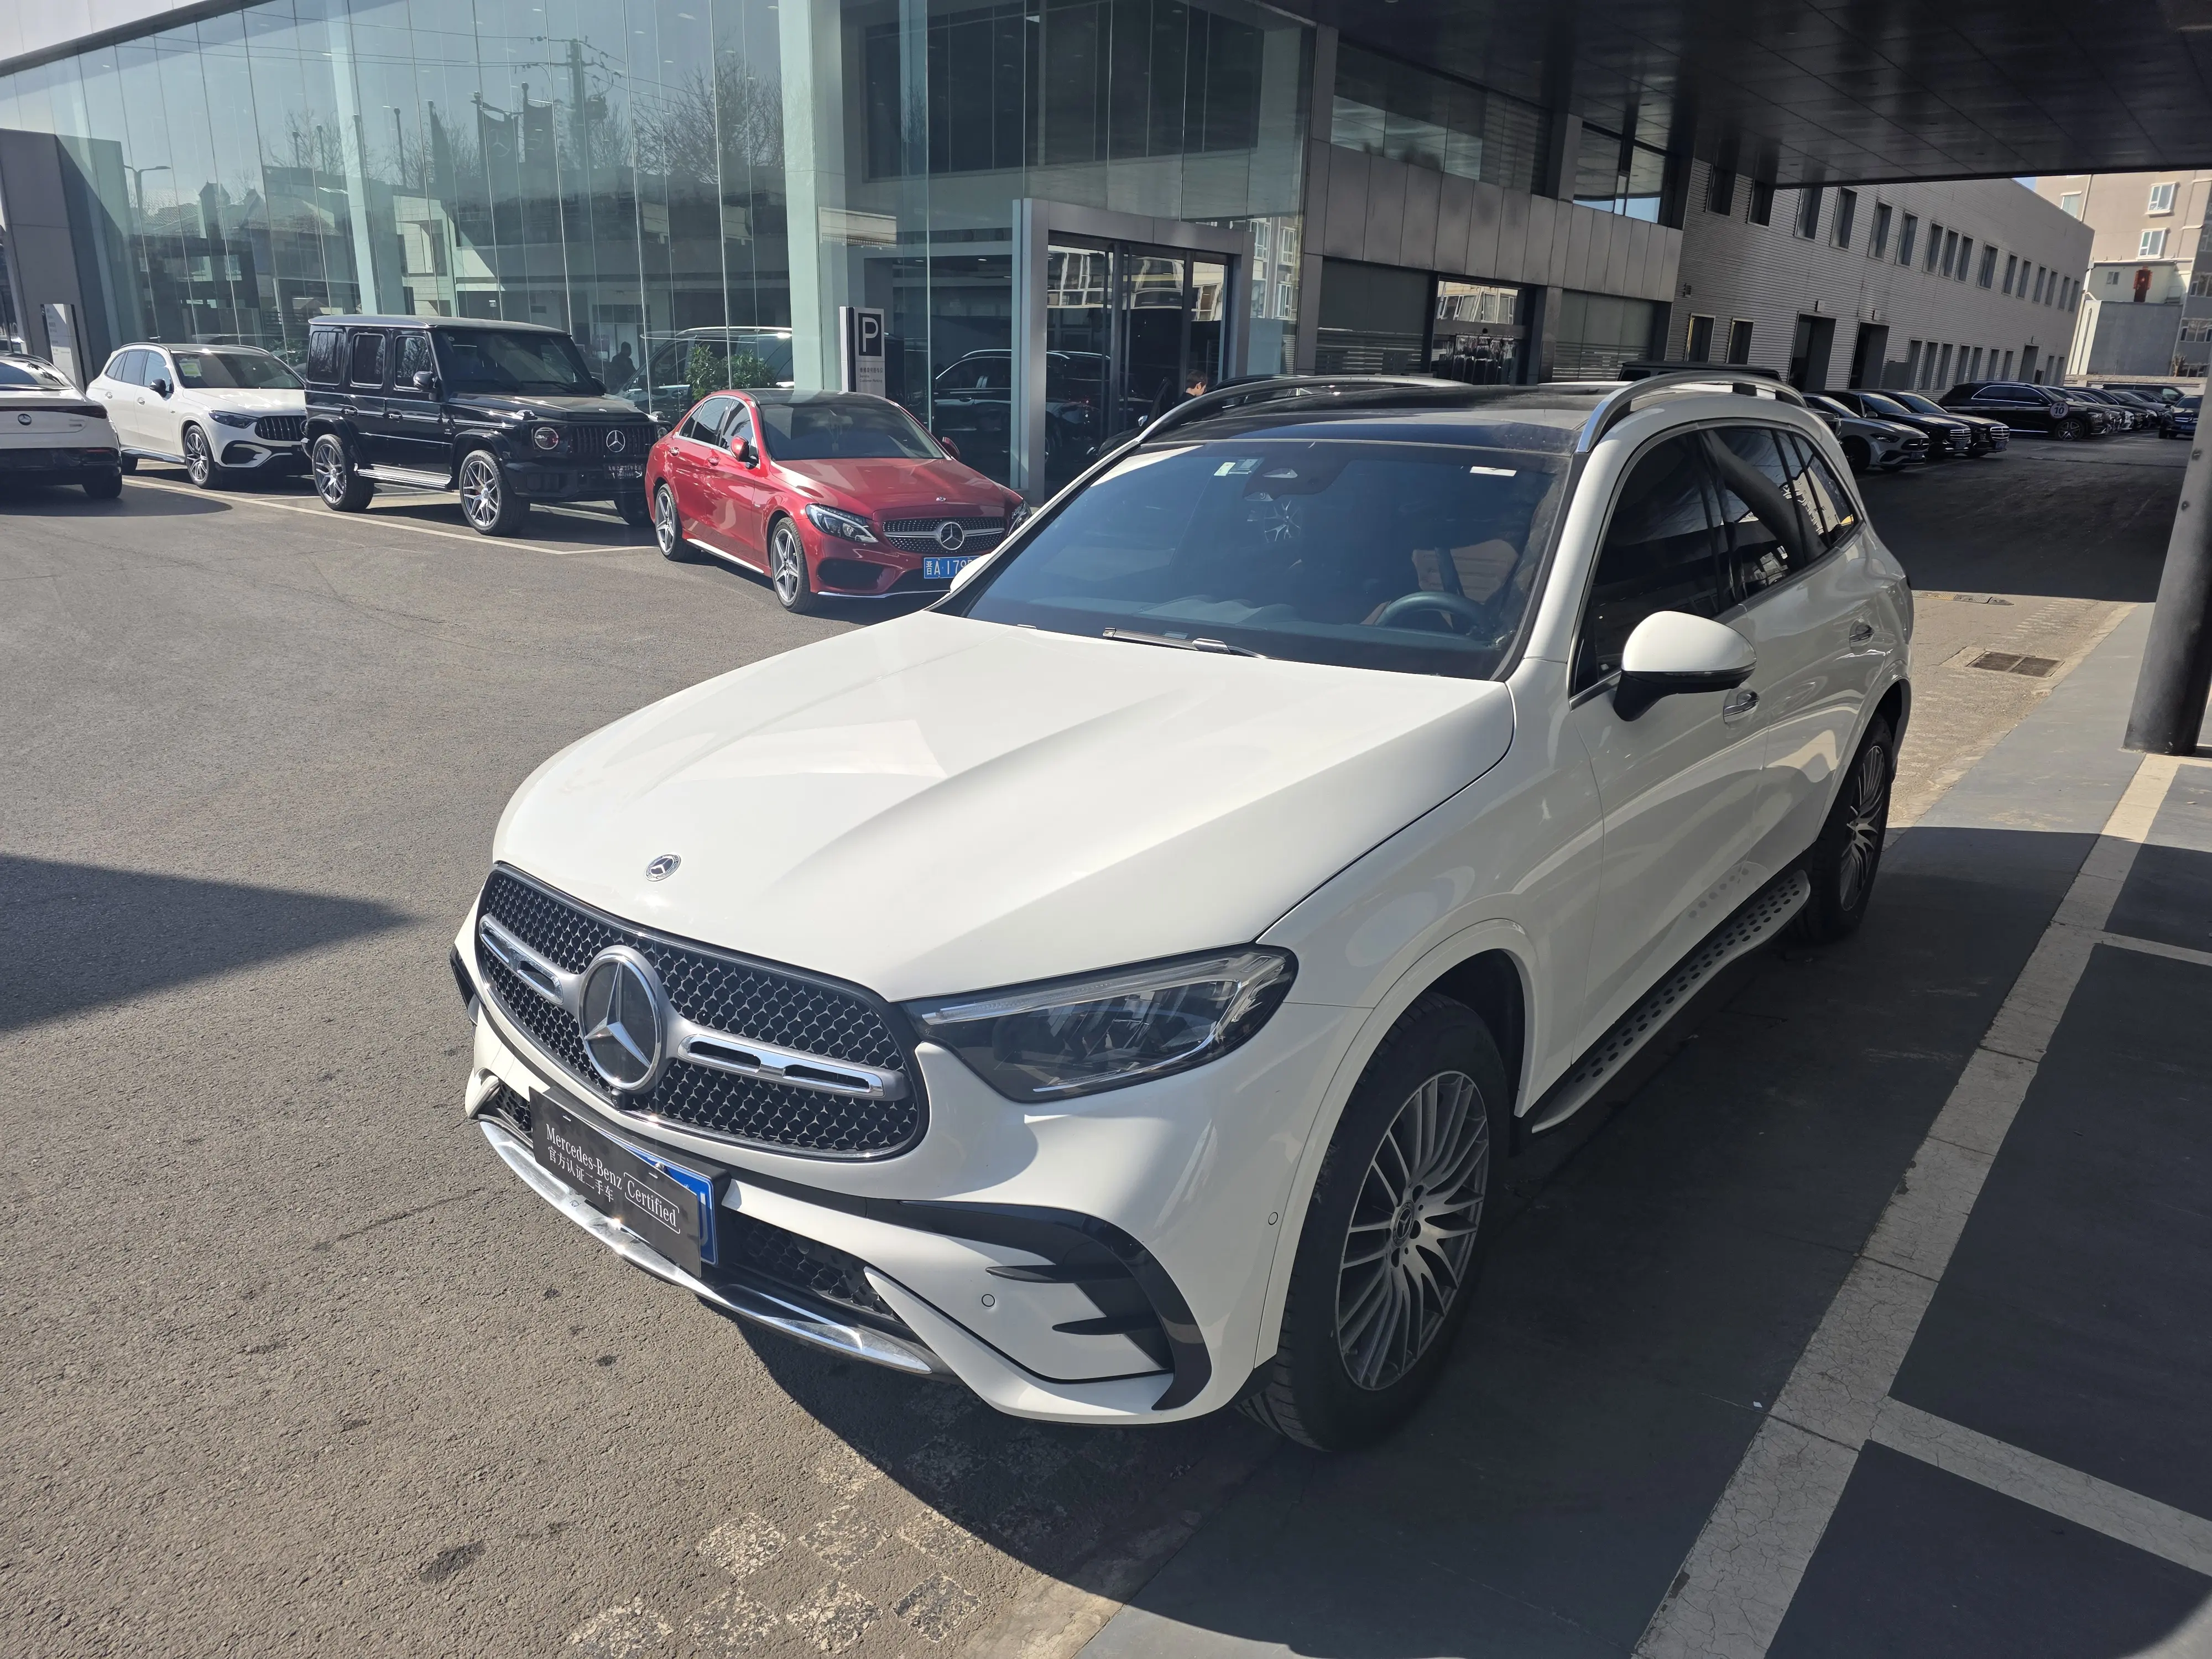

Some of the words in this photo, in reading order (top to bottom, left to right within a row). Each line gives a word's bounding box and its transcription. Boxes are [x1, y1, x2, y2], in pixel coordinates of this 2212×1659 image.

[863, 317, 878, 352] P
[546, 1123, 623, 1190] Mercedes-Benz
[627, 1180, 677, 1227] Certified
[547, 1145, 614, 1203] 官方认证二手车
